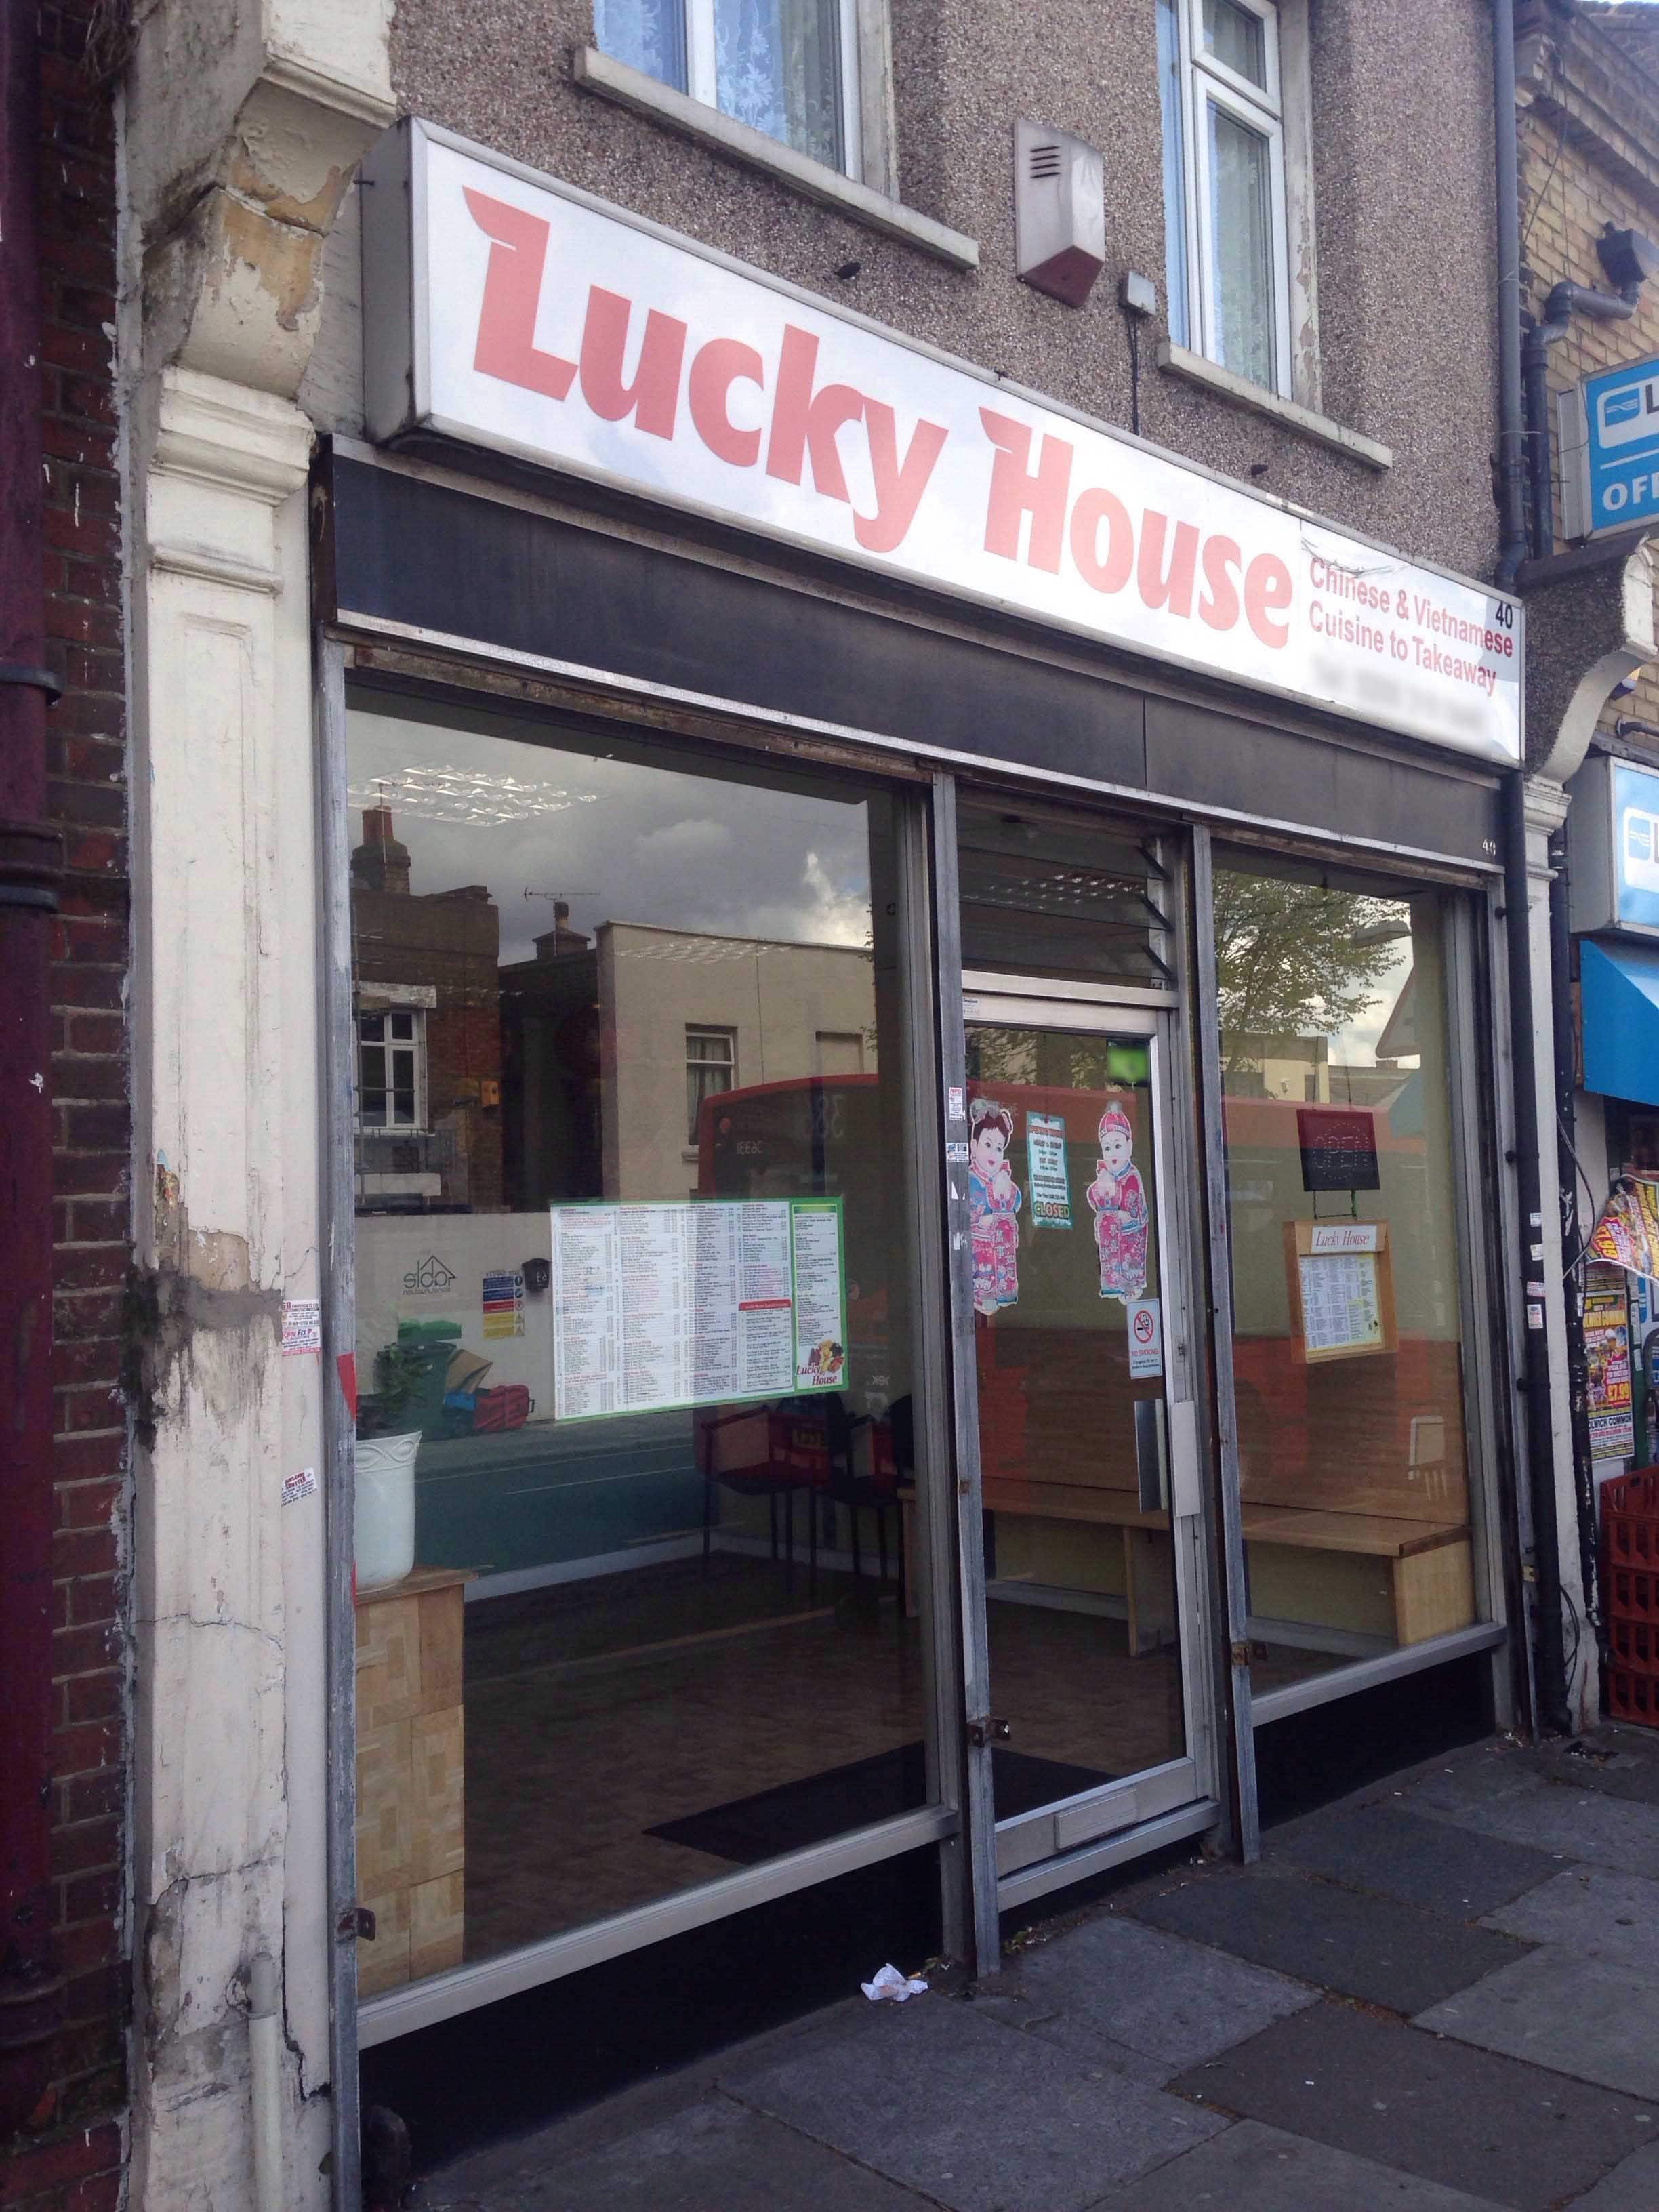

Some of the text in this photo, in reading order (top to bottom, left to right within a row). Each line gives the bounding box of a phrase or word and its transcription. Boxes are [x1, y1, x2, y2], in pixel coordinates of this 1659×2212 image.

[462, 186, 1292, 649] Lucky House
[1310, 558, 1513, 657] Chinese & Vietnamese
[1495, 601, 1513, 629] 40
[1309, 600, 1383, 653] Cuisine
[1389, 629, 1408, 661] to
[1412, 635, 1496, 697] Takeaway
[1034, 1202, 1069, 1218] CLOSED
[1316, 1230, 1369, 1246] Lucky House
[796, 1362, 821, 1376] Lucky
[813, 1376, 837, 1385] House
